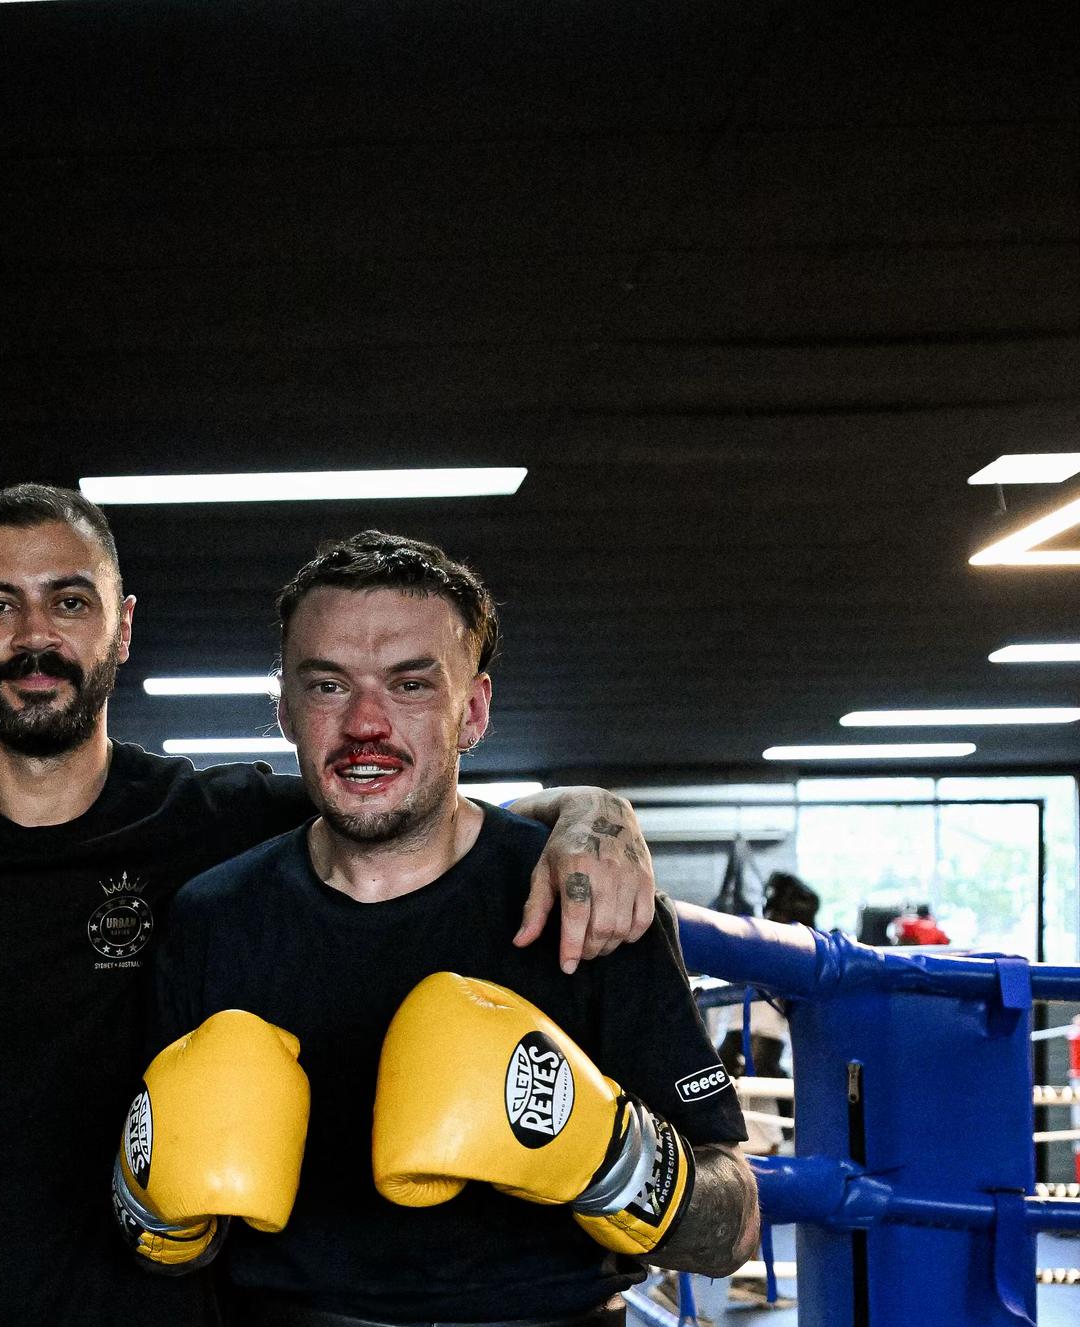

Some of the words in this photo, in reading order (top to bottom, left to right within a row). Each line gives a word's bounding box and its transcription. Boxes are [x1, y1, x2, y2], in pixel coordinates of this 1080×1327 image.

[520, 1046, 560, 1136] REYES
[682, 1070, 726, 1096] reece
[129, 1092, 146, 1175] REYES
[659, 1131, 675, 1203] PROFESIONAL
